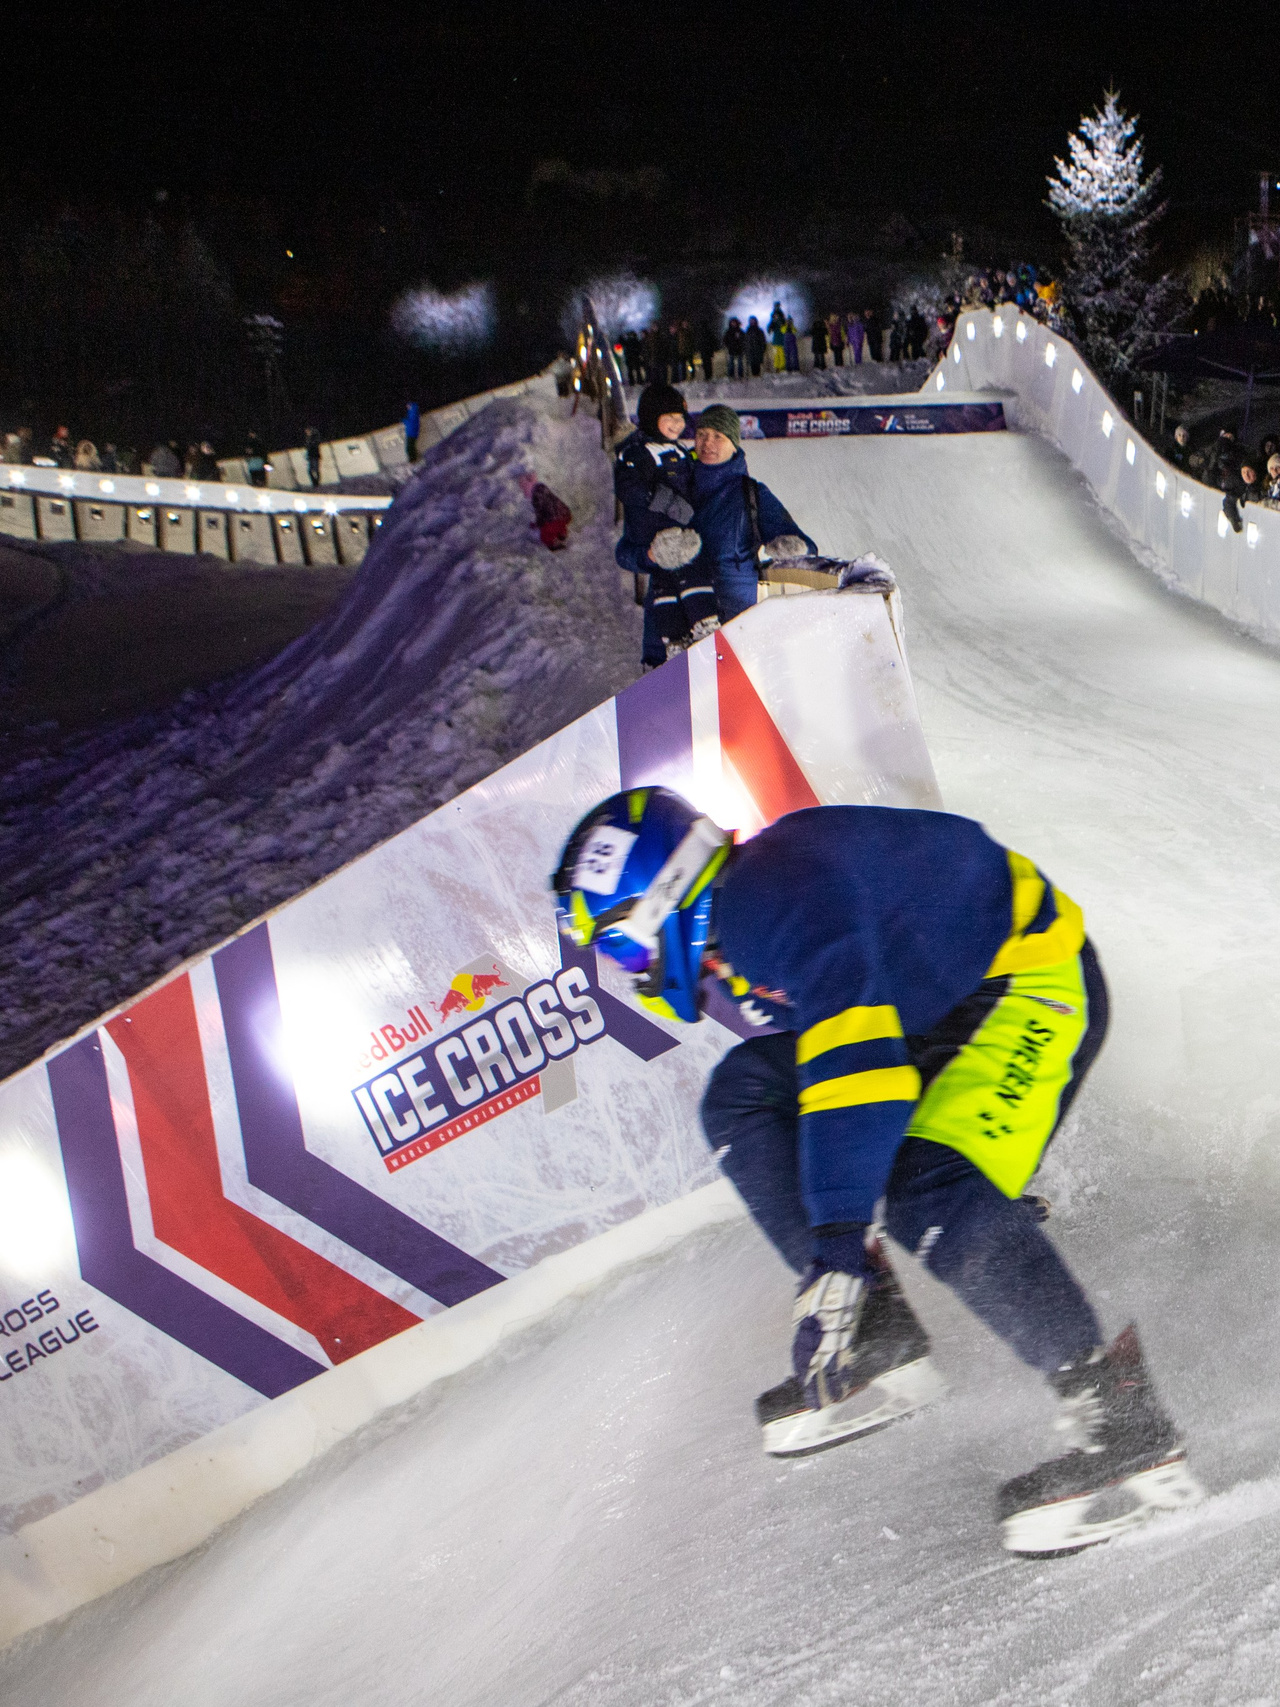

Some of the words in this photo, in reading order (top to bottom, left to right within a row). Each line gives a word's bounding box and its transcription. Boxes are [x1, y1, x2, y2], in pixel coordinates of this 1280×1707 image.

[354, 1056, 449, 1151] ICE
[435, 966, 605, 1106] CROSS
[390, 1141, 431, 1168] WORLD
[438, 1083, 536, 1141] CHAMPIONSHIP
